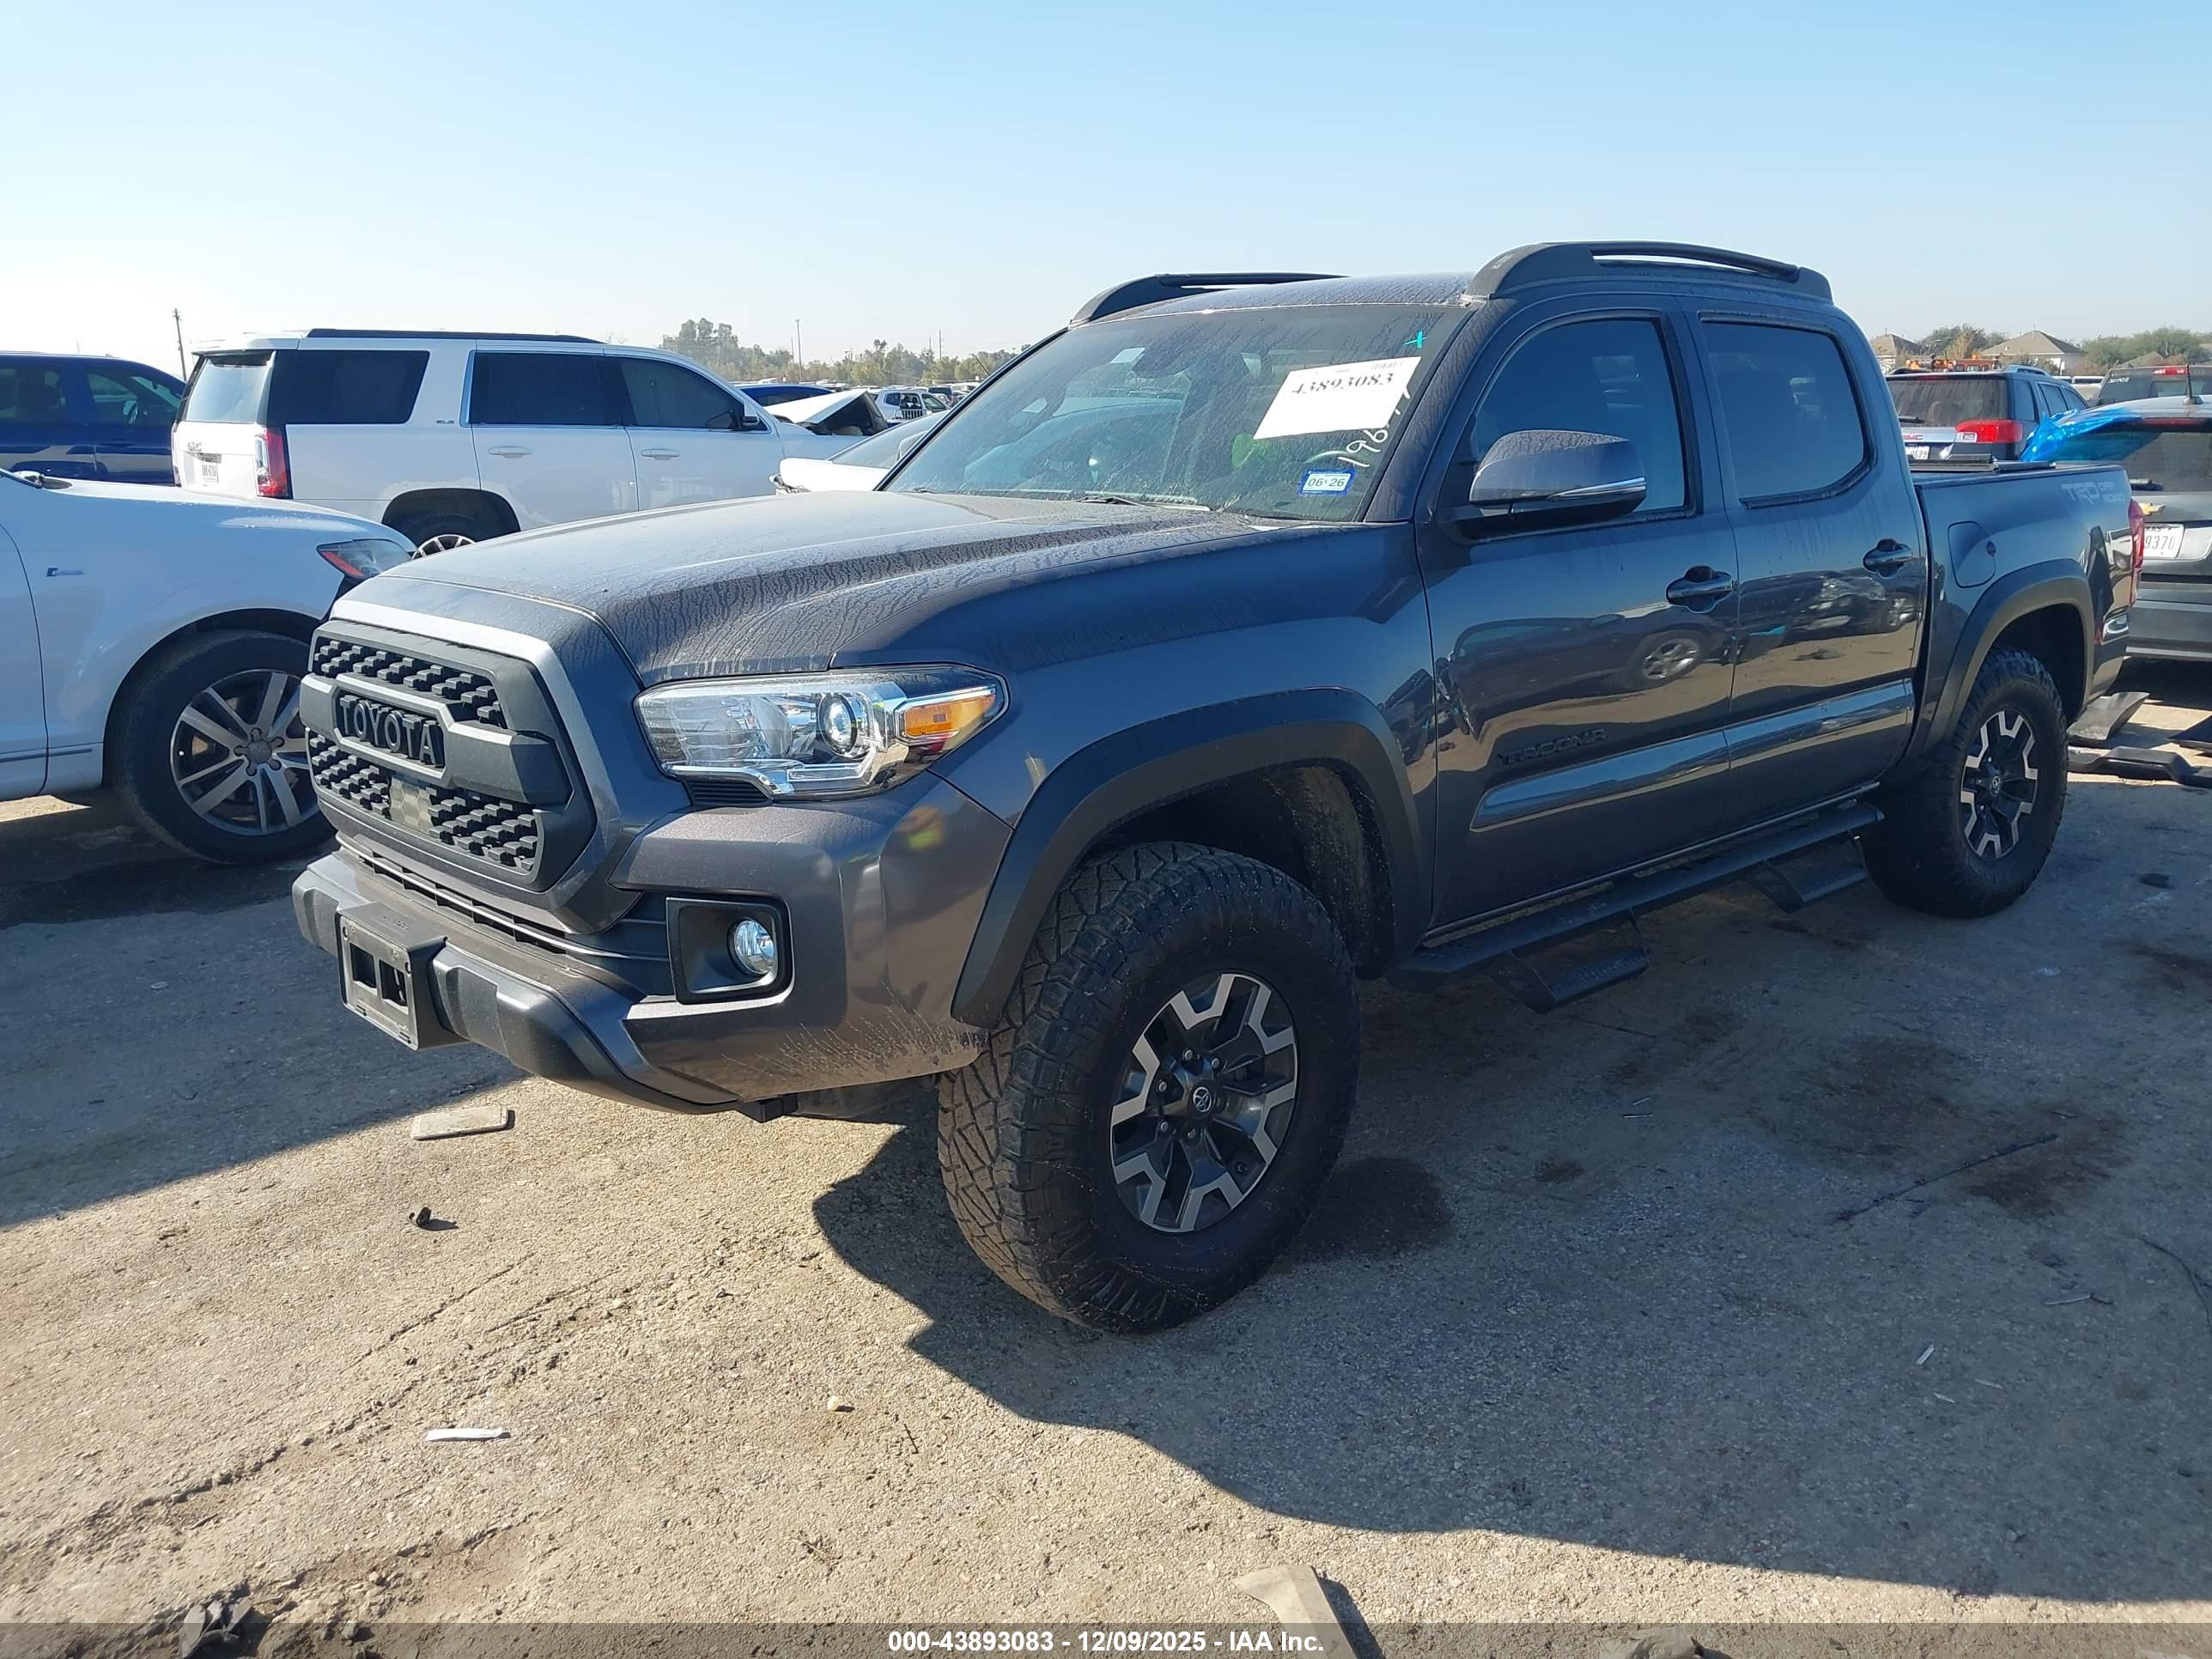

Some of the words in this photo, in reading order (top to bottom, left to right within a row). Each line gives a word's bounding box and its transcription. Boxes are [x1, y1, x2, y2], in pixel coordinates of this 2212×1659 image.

[1291, 373, 1395, 394] 43893083
[1308, 477, 1324, 487] 06
[1328, 477, 1346, 487] 26
[2061, 481, 2100, 505] TRD
[339, 695, 444, 767] TOYOTA
